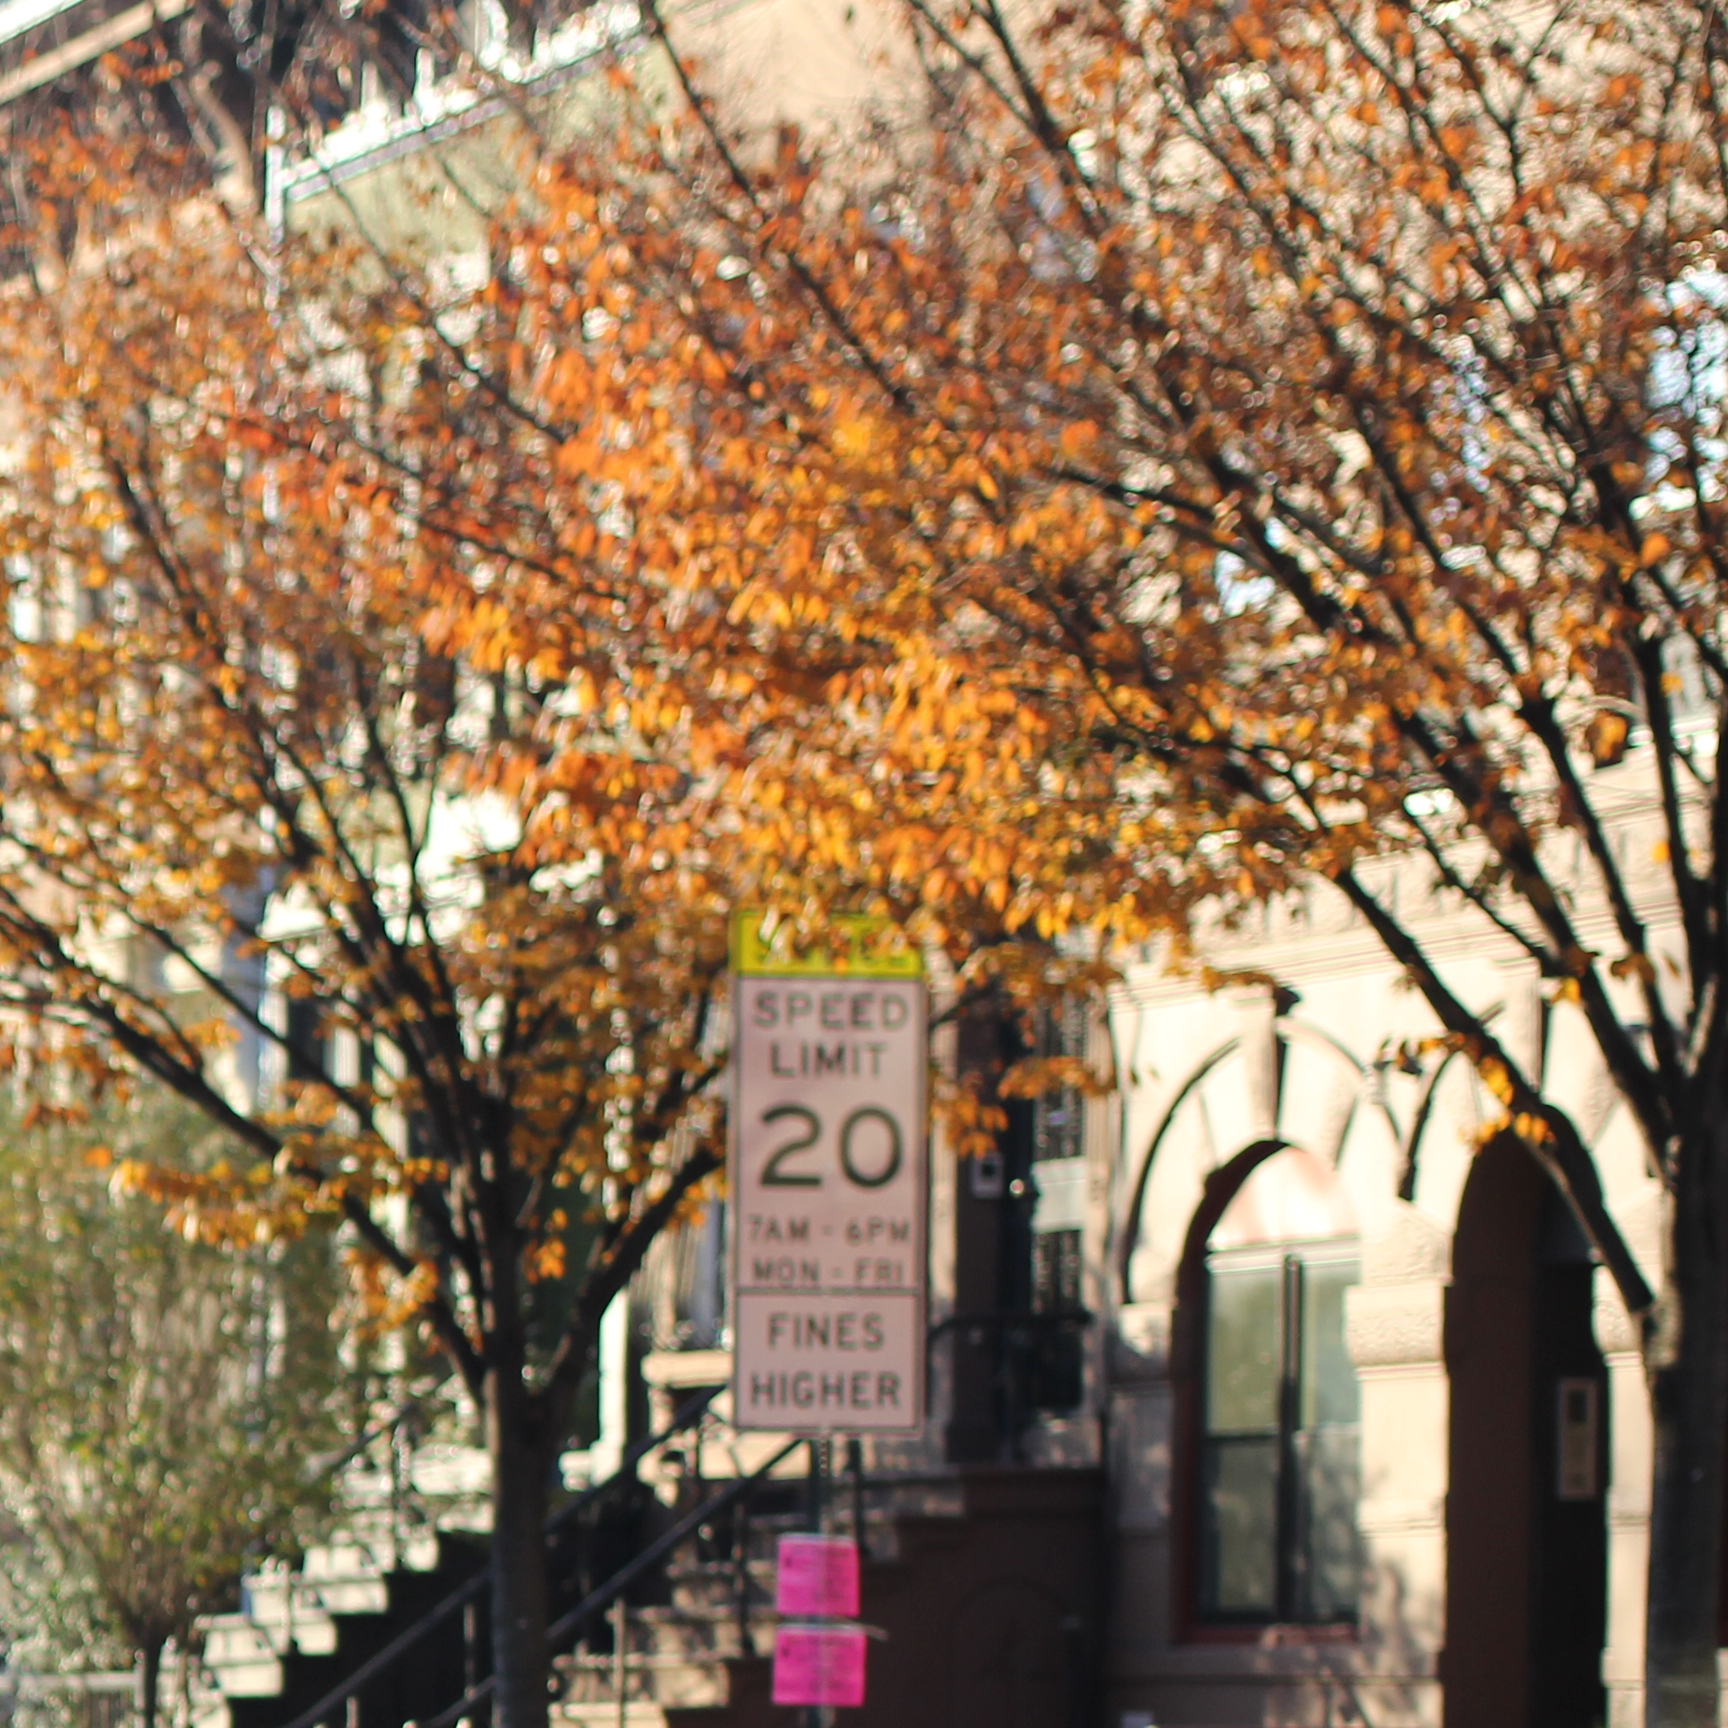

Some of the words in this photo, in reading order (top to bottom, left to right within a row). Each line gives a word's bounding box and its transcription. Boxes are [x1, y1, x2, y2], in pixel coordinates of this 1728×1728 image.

[754, 991, 910, 1030] SPEED
[771, 1040, 887, 1078] LIMIT
[759, 1104, 904, 1188] 20
[748, 1215, 811, 1241] 7AM
[847, 1217, 911, 1244] 6PM
[753, 1258, 820, 1283] MON
[855, 1258, 903, 1284] FRI
[769, 1312, 885, 1349] FINES
[750, 1371, 902, 1408] HIGHER
